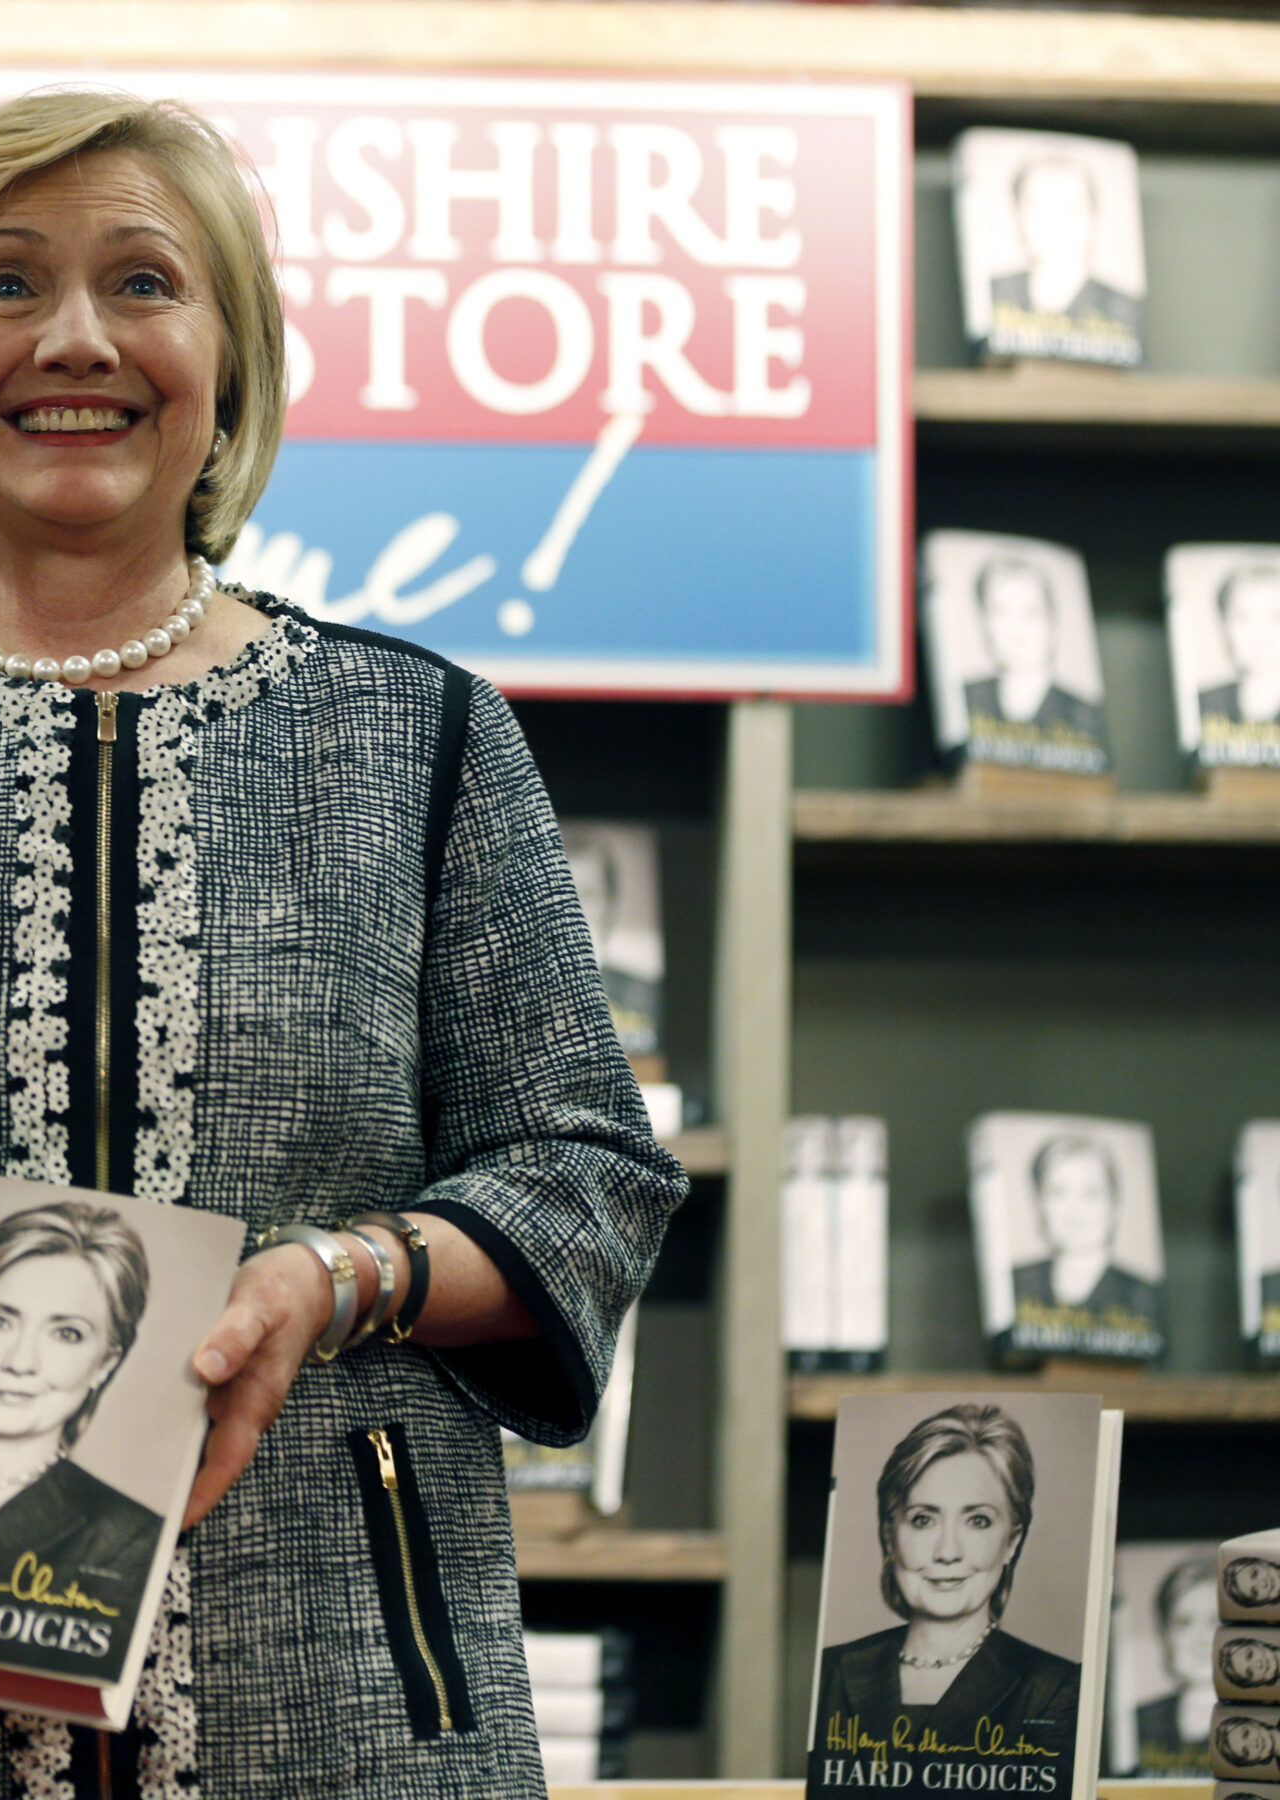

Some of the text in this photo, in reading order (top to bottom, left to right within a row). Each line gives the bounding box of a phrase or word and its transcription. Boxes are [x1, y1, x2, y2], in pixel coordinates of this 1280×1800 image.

[11, 1551, 120, 1617] Clinton
[826, 1710, 888, 1772] Hillary
[974, 1715, 1060, 1757] Clinton
[822, 1759, 1058, 1793] HARD CHOICES
